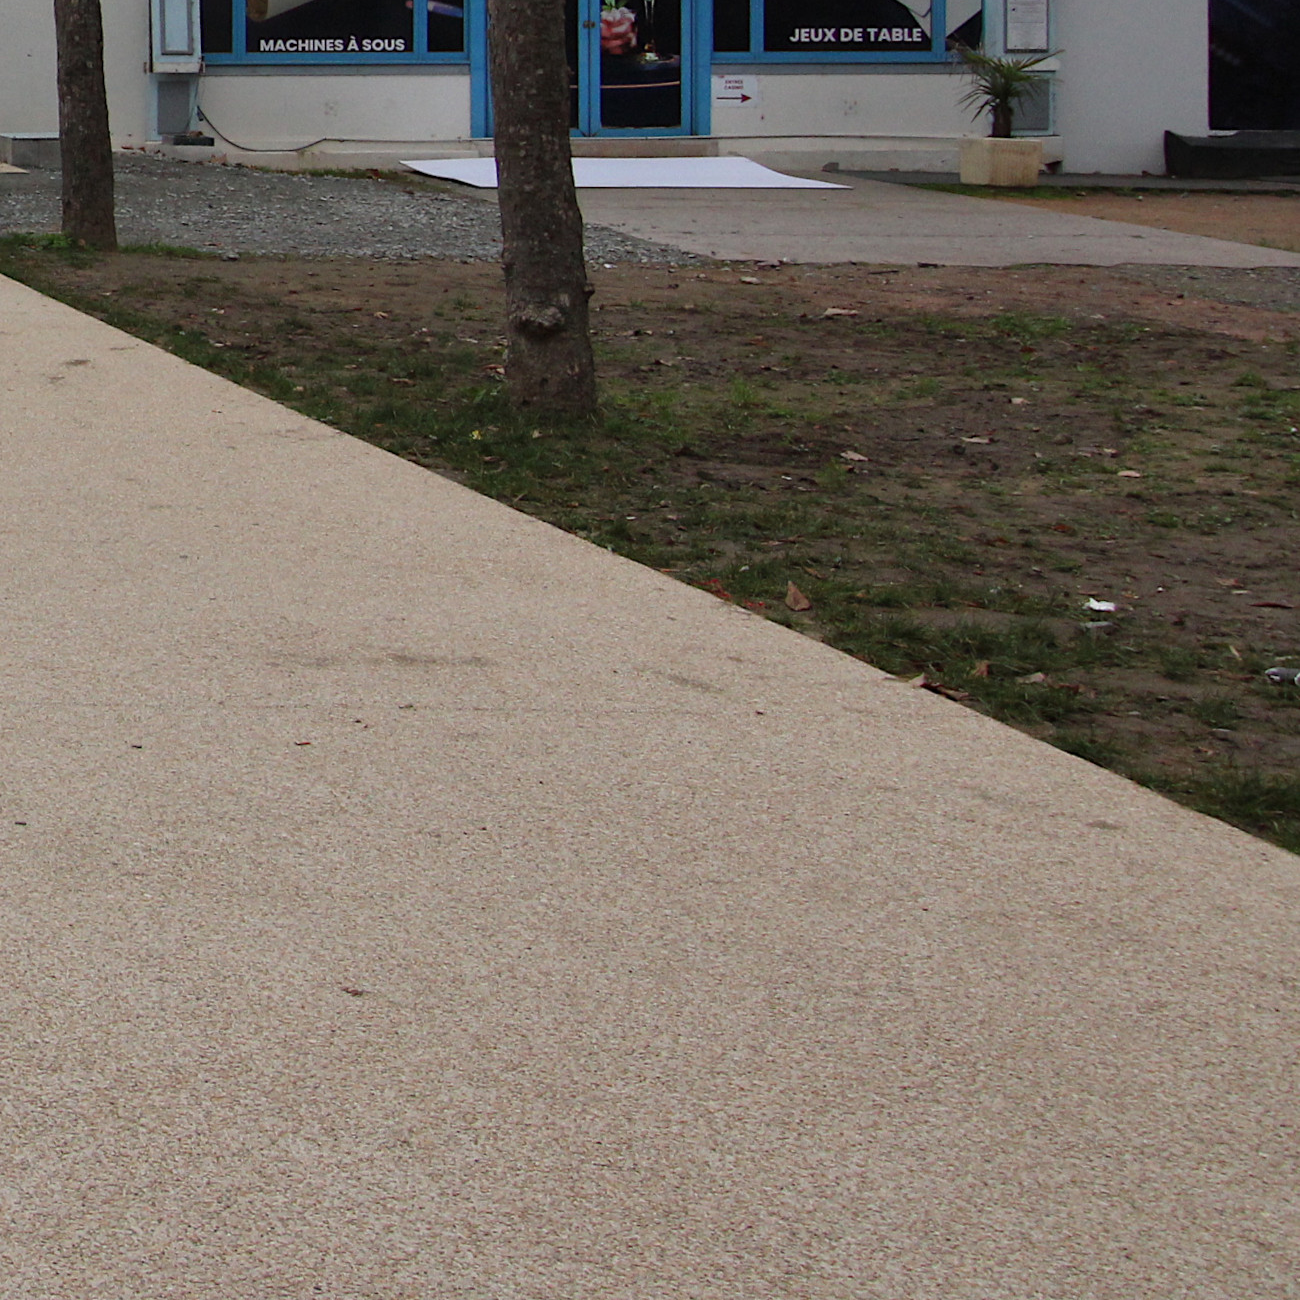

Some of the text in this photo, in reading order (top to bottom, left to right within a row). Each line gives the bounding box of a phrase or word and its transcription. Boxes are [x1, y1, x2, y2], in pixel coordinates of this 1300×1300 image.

[259, 34, 405, 52] MACHINES À SOUS
[789, 28, 922, 42] JEUX DE TABLE
